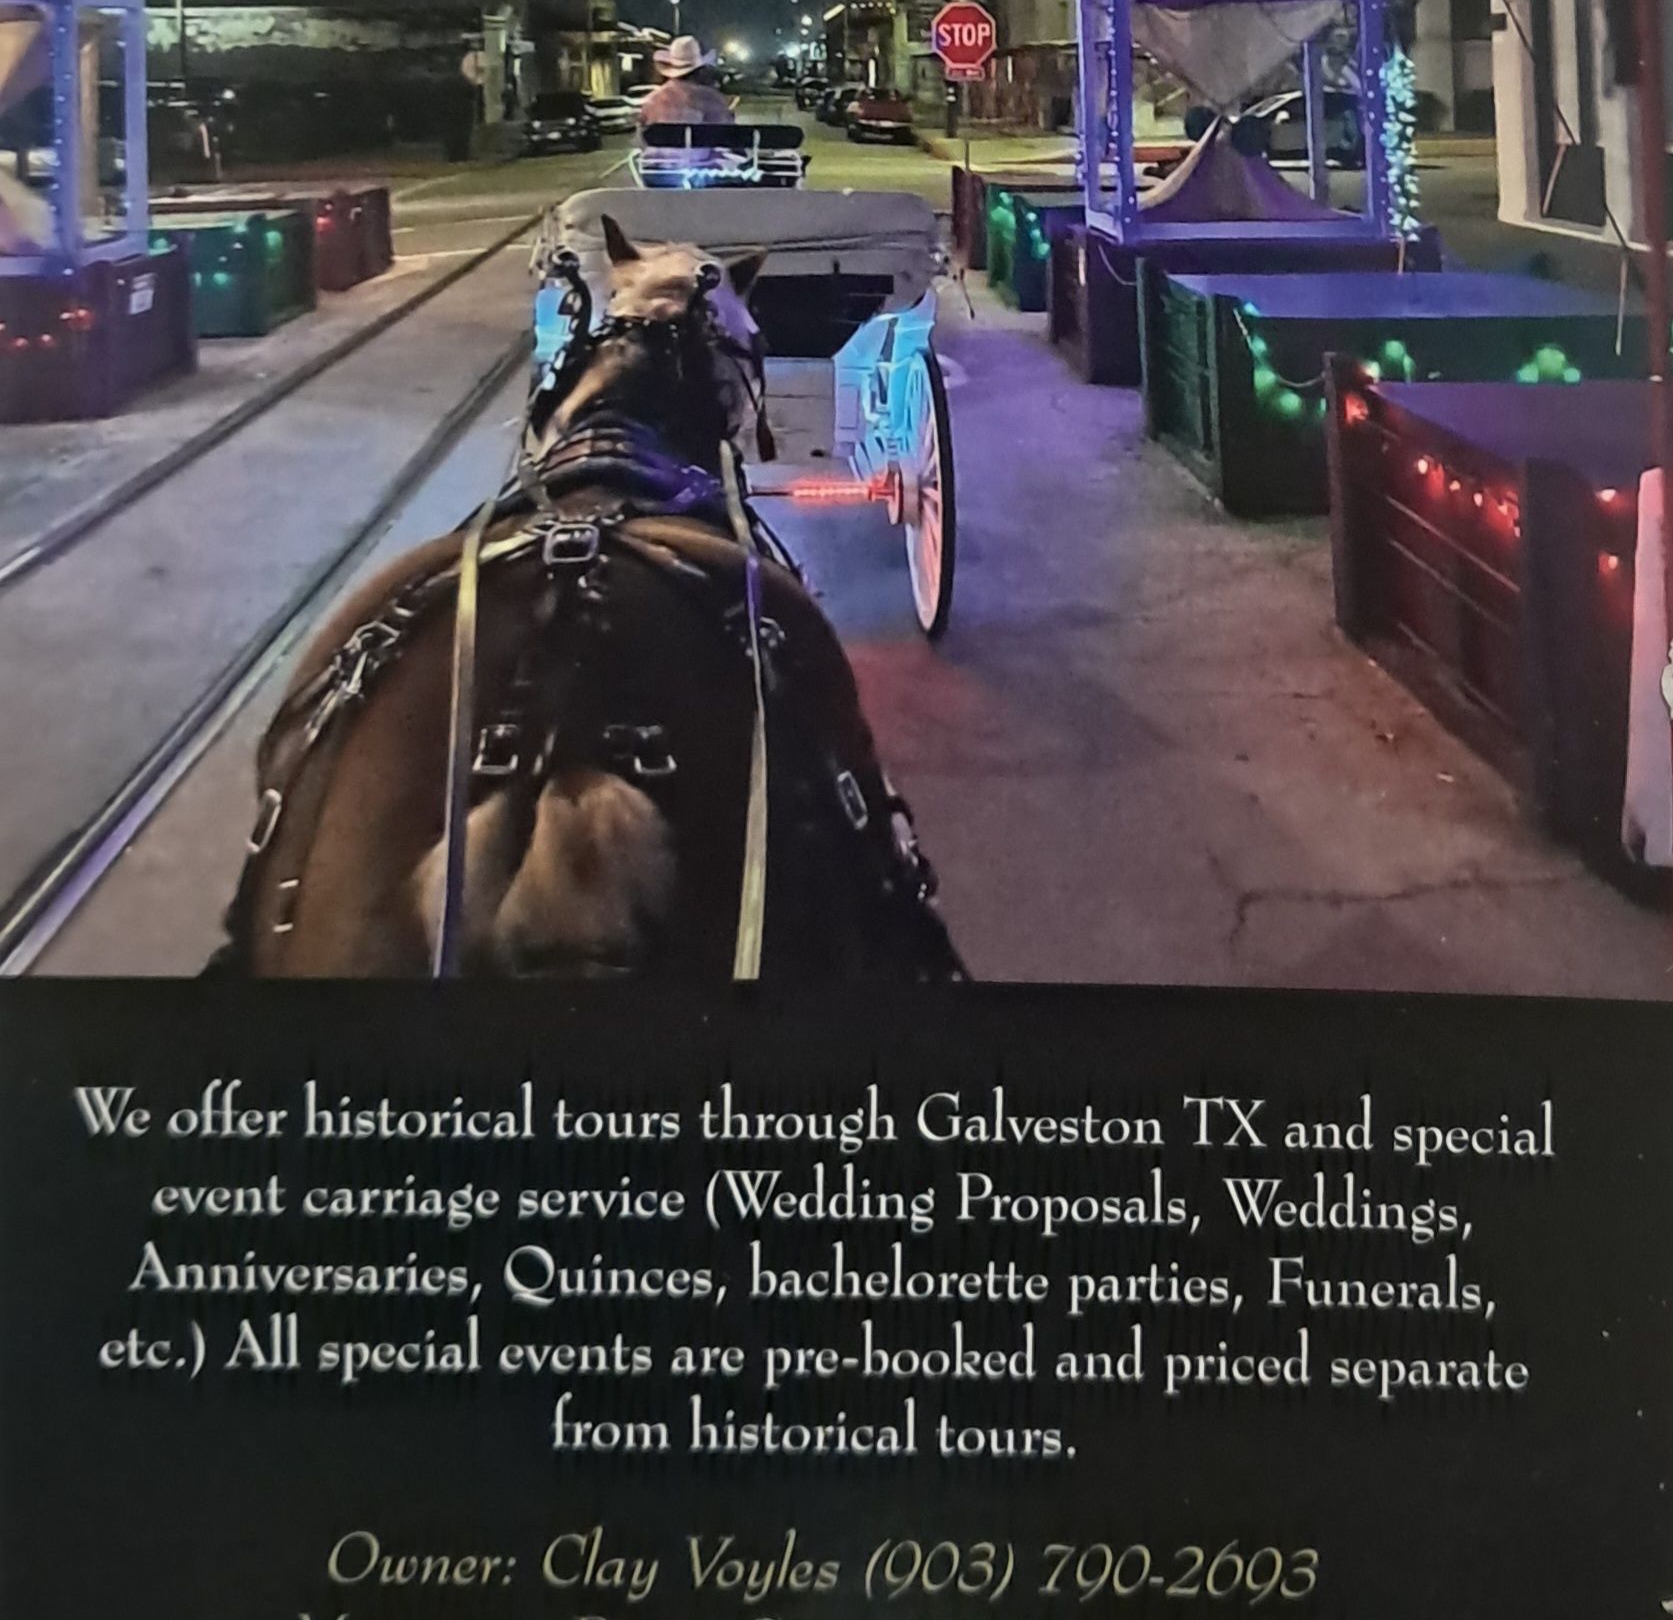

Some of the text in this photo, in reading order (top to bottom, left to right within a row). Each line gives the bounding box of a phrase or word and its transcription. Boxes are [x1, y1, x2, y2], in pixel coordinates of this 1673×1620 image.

[937, 22, 991, 48] STOP
[75, 1078, 1555, 1166] We offer historical tours through Galveston TX and special
[153, 1162, 1472, 1244] event carriage service (Wedding Proposals, Weddings,
[129, 1239, 1495, 1319] Anniversaries, Quinces, bachelorette parties, Funerals,
[99, 1312, 1529, 1399] etc.) All special events are pre-booked and priced separate
[553, 1391, 1076, 1458] from historical tours.
[327, 1525, 1320, 1604] Owner: Clay Voyles (903) 790-2693
